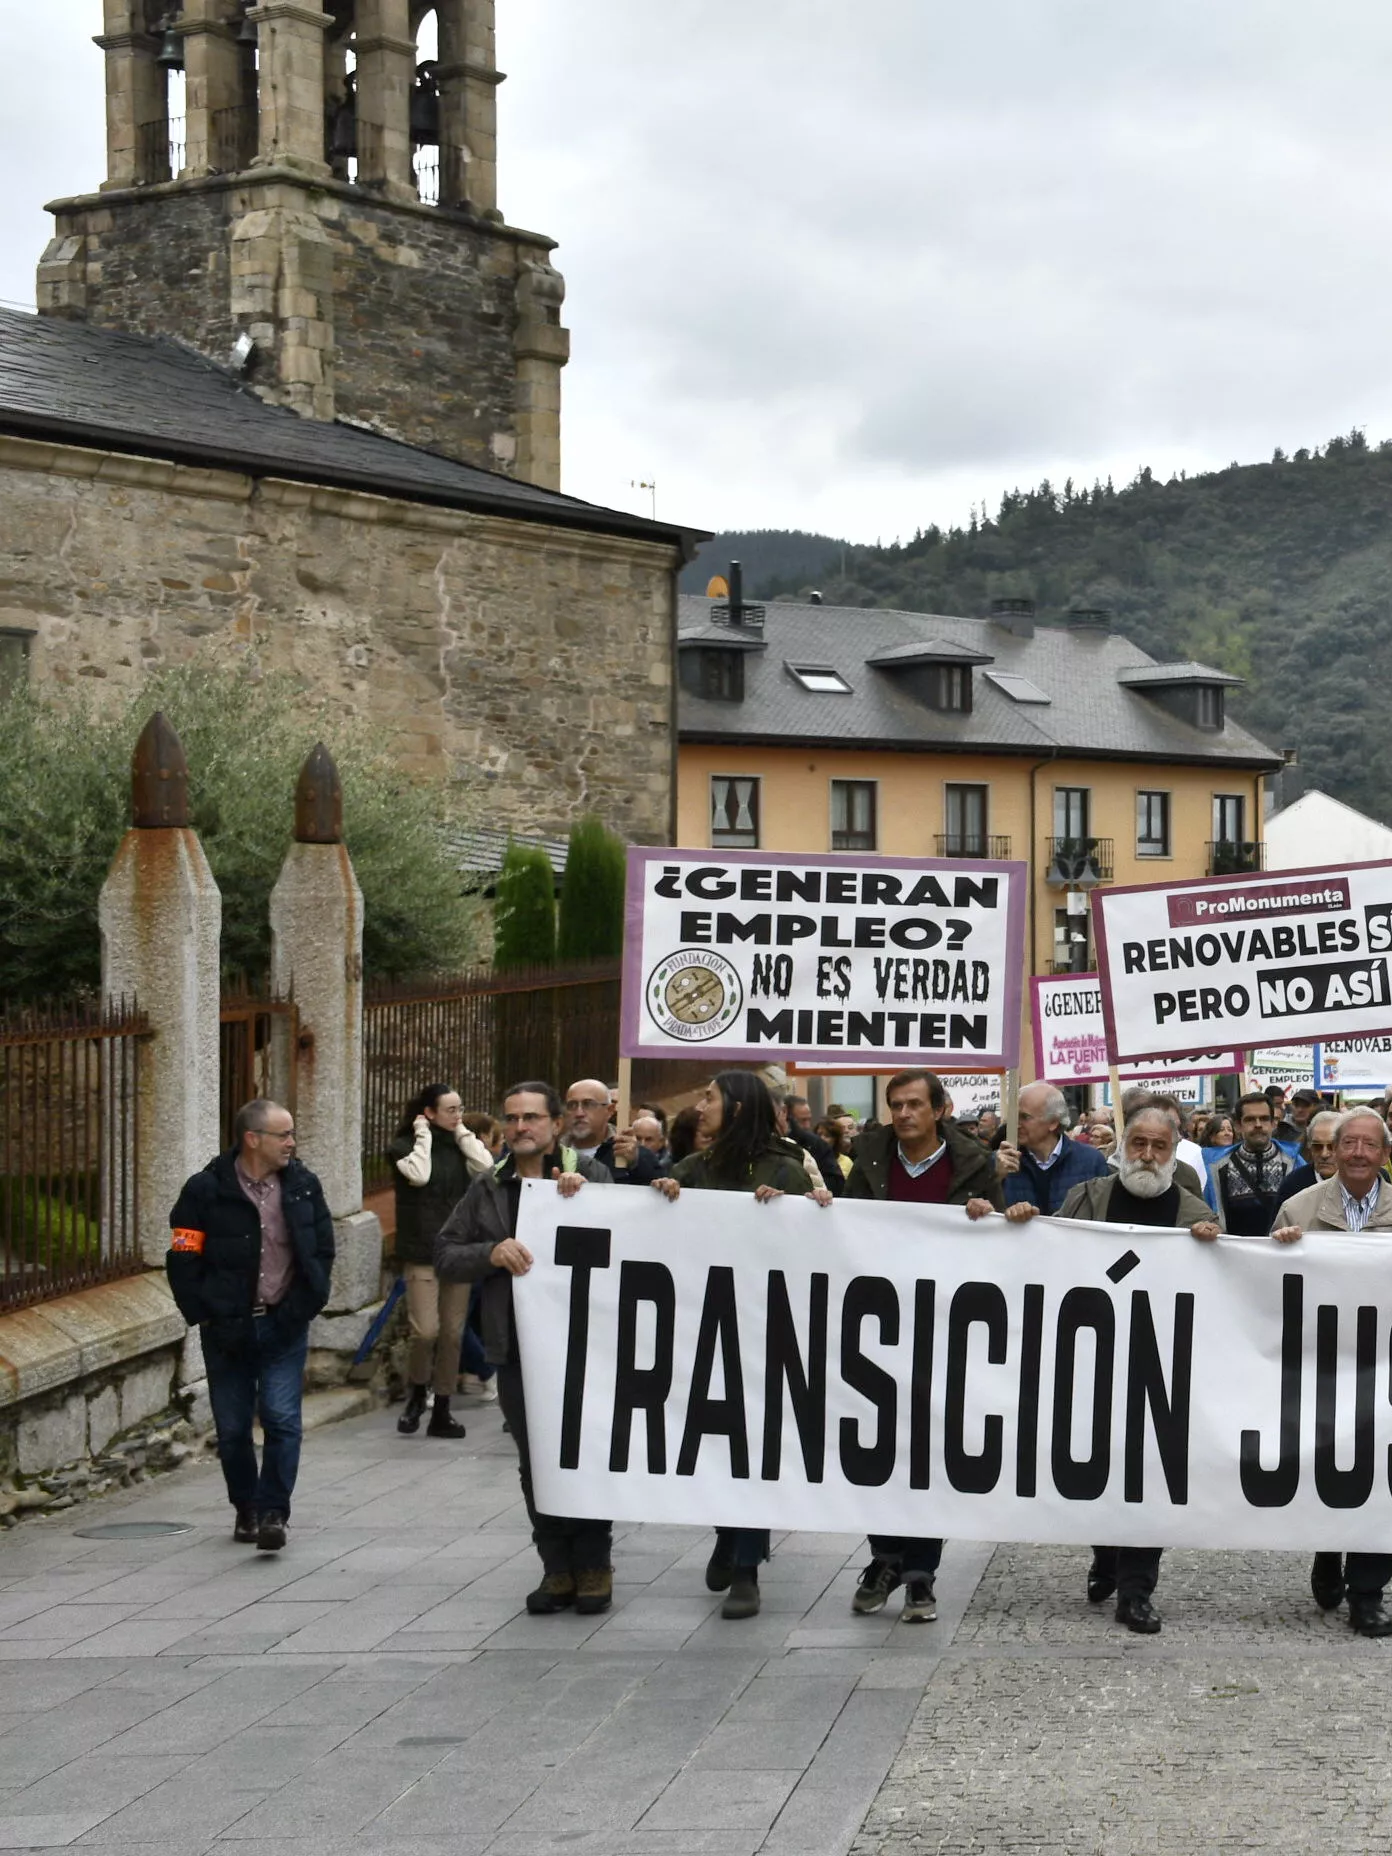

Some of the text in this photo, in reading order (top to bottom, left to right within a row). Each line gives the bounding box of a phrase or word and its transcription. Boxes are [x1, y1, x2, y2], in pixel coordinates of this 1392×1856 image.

[654, 866, 998, 908] ¿GENERAN
[1195, 888, 1343, 916] ProMonumenta
[680, 911, 973, 951] EMPLEO?
[1123, 918, 1360, 974] RENOVABLES
[750, 953, 990, 1005] NO ES VERDAD
[1154, 960, 1384, 1025] PERO NO ASÍ
[746, 1007, 988, 1050] MIENTEN
[1051, 1048, 1105, 1065] LA FUENT
[554, 1225, 1195, 1506] TRANSICIÓN
